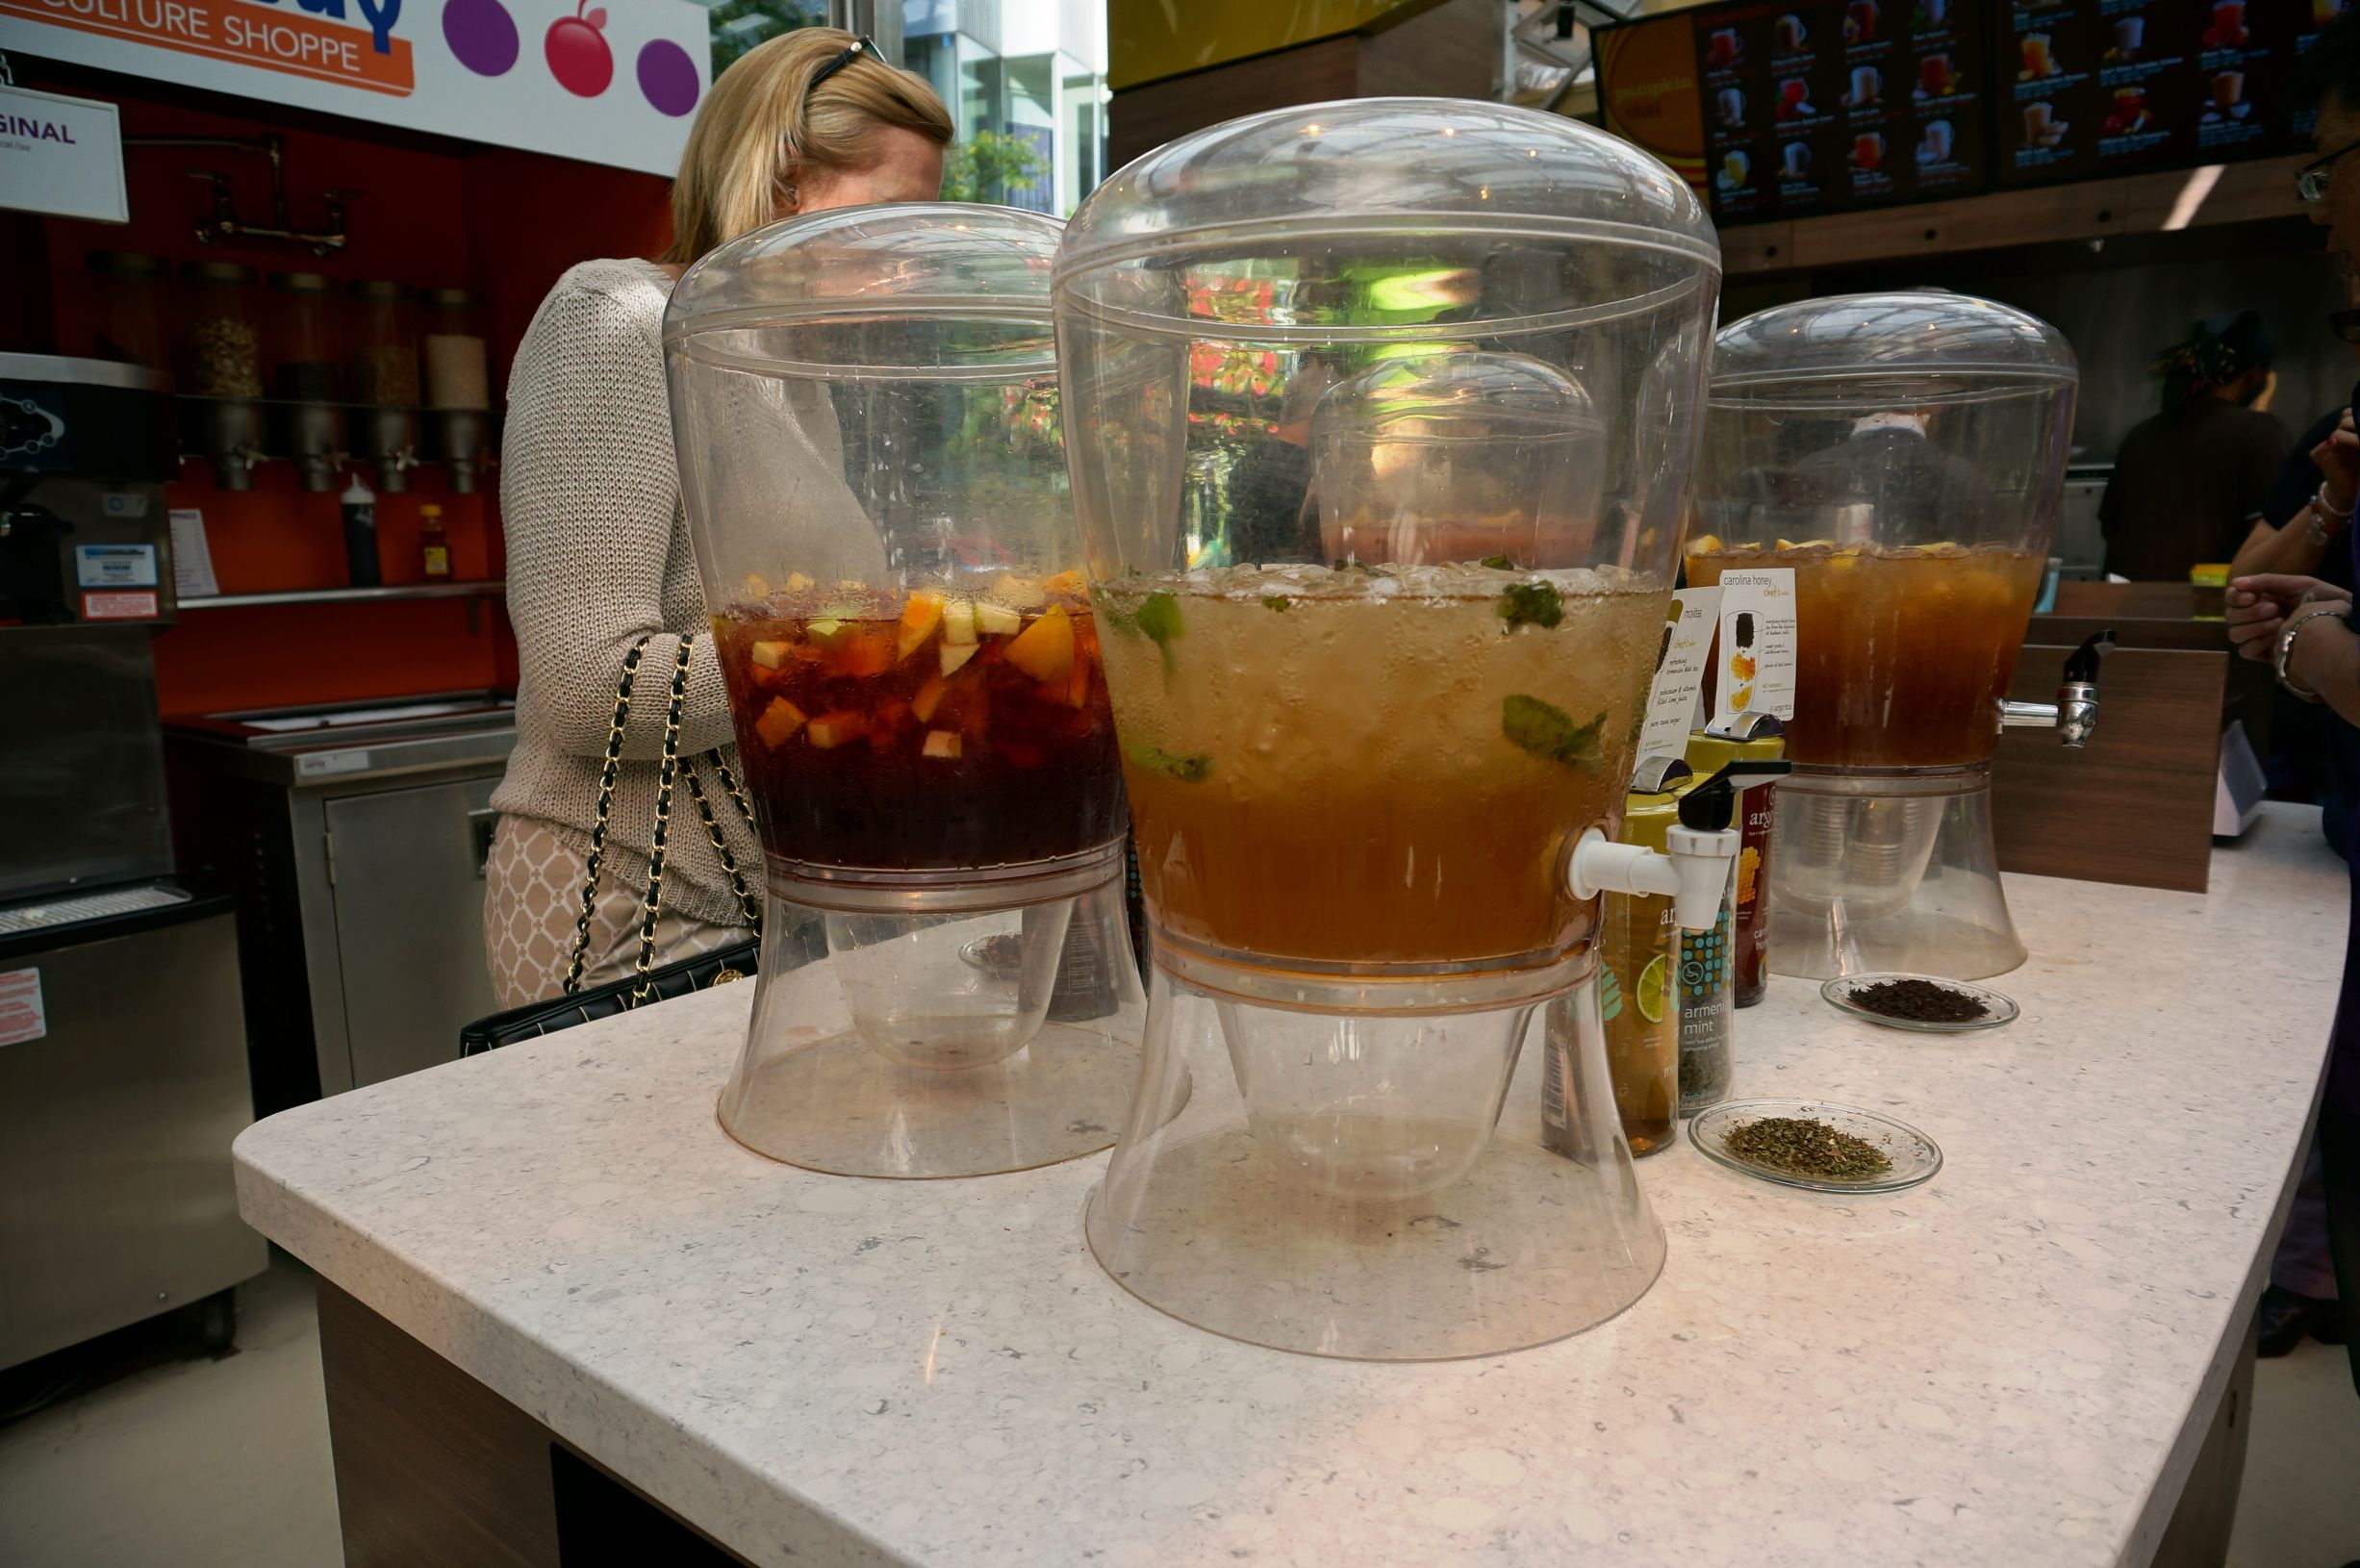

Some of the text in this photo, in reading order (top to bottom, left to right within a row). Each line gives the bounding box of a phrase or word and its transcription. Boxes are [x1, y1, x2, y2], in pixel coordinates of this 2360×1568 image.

[42, 0, 211, 39] LTURE
[222, 15, 361, 73] SHOPPE
[1723, 574, 1772, 587] carolina honey
[1684, 1020, 1714, 1035] mint
